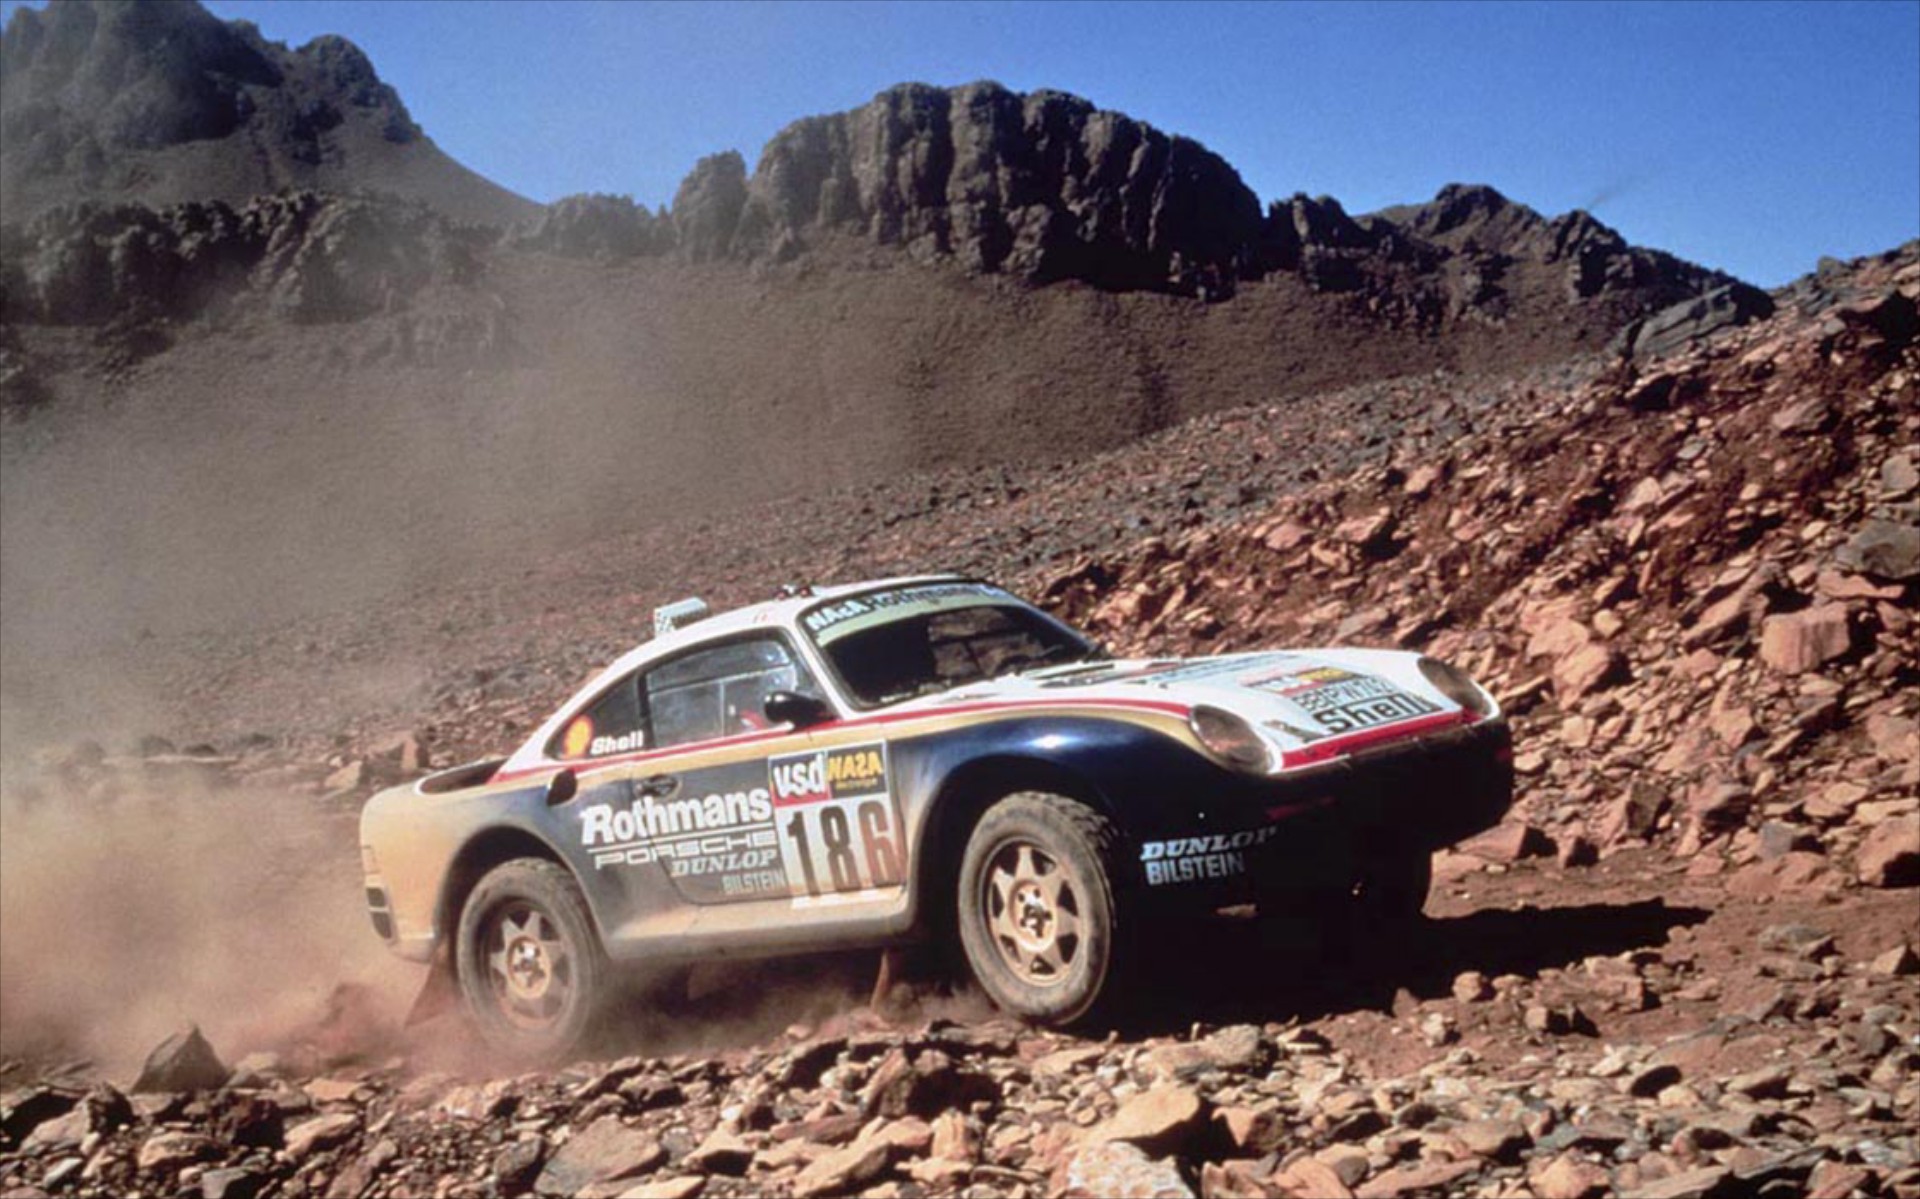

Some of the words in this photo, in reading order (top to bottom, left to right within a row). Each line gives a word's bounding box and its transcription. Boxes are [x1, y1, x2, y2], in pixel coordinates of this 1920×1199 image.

[1312, 693, 1422, 734] Shell
[590, 729, 644, 755] Shell
[581, 788, 773, 845] Rothmans
[595, 830, 778, 870] PORSCHE
[786, 799, 895, 897] 186
[1140, 826, 1277, 861] DUNLOP
[670, 849, 777, 878] DUNLOP
[1146, 852, 1245, 886] BILSTEIN
[722, 869, 787, 895] BILSTEIN
